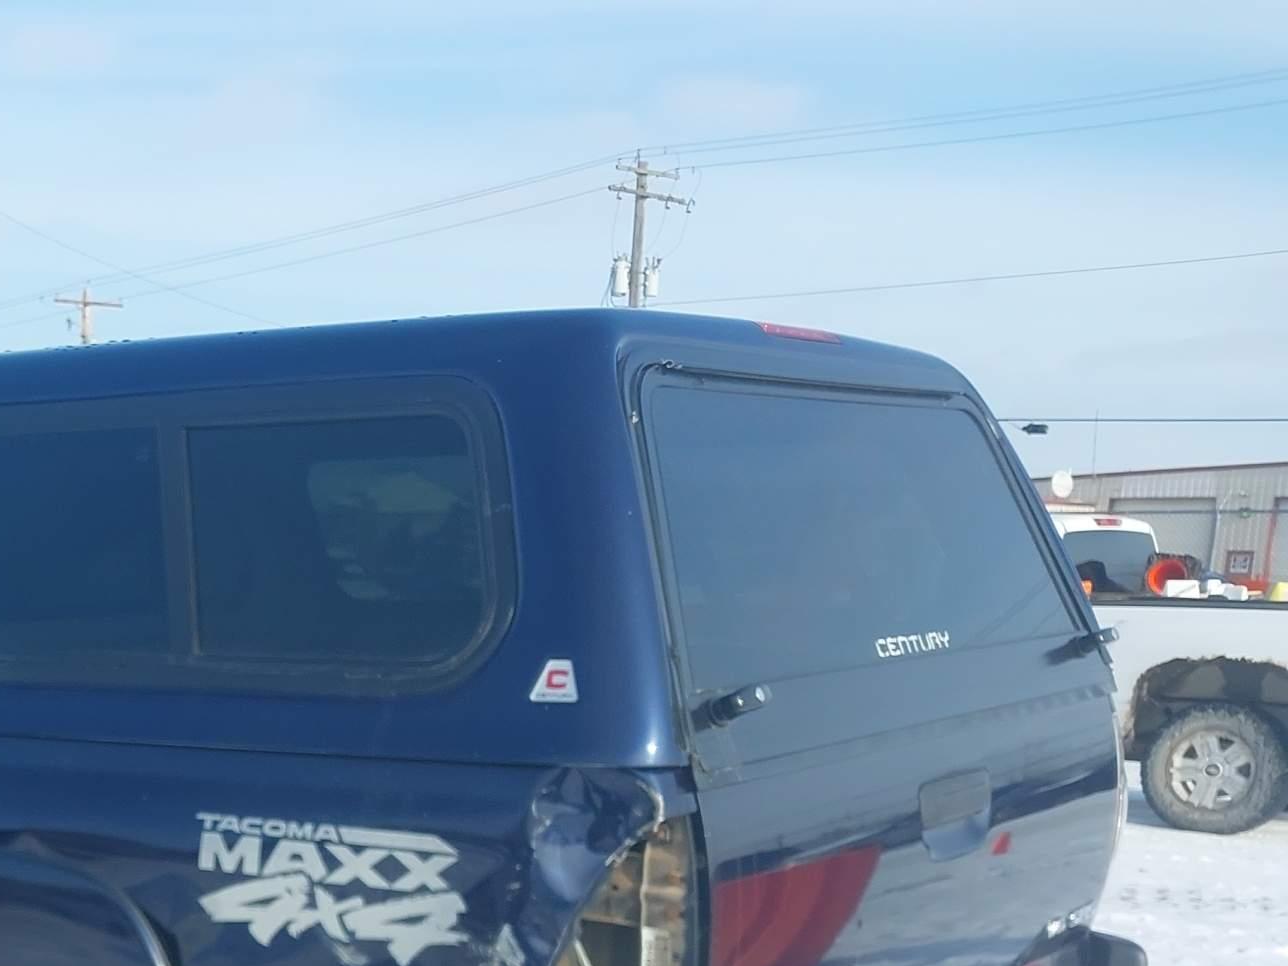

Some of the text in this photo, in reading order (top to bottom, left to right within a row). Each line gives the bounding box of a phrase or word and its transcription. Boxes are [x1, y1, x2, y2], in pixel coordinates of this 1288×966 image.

[875, 630, 949, 657] CENTURY
[546, 669, 569, 688] C
[196, 812, 341, 842] TACOMA
[198, 831, 459, 892] MAXX
